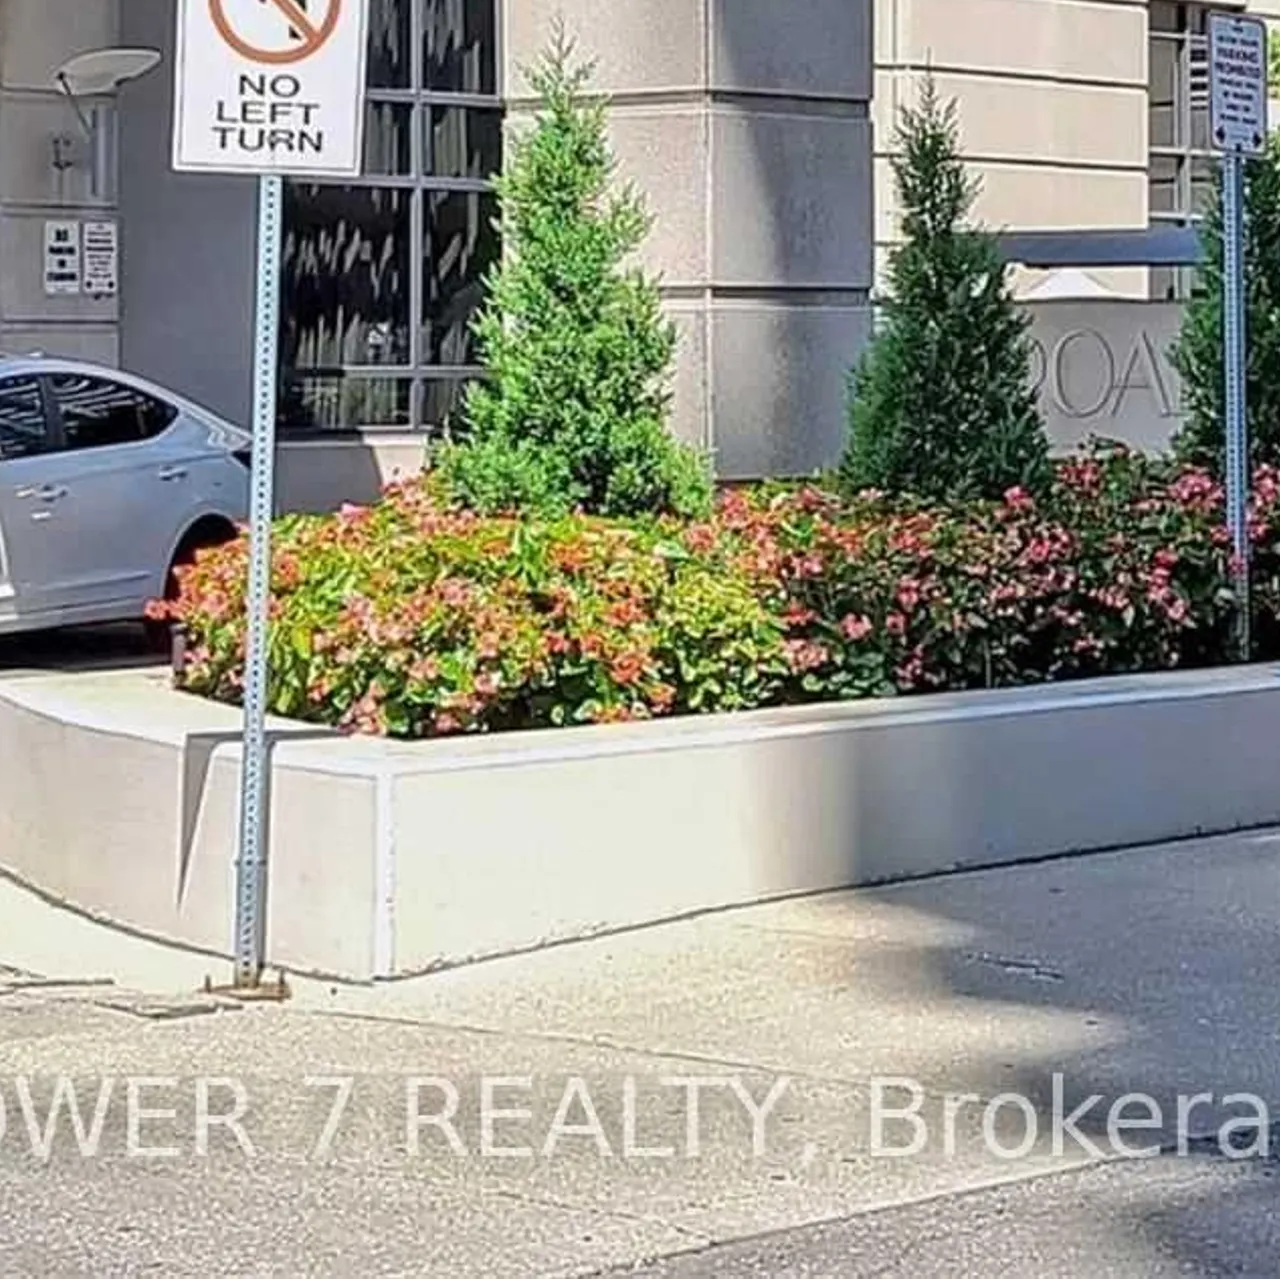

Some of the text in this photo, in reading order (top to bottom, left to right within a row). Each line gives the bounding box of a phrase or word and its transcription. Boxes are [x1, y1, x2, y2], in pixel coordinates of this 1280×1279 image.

[238, 74, 301, 98] NO
[216, 100, 320, 126] LEFT
[211, 126, 323, 153] TURN
